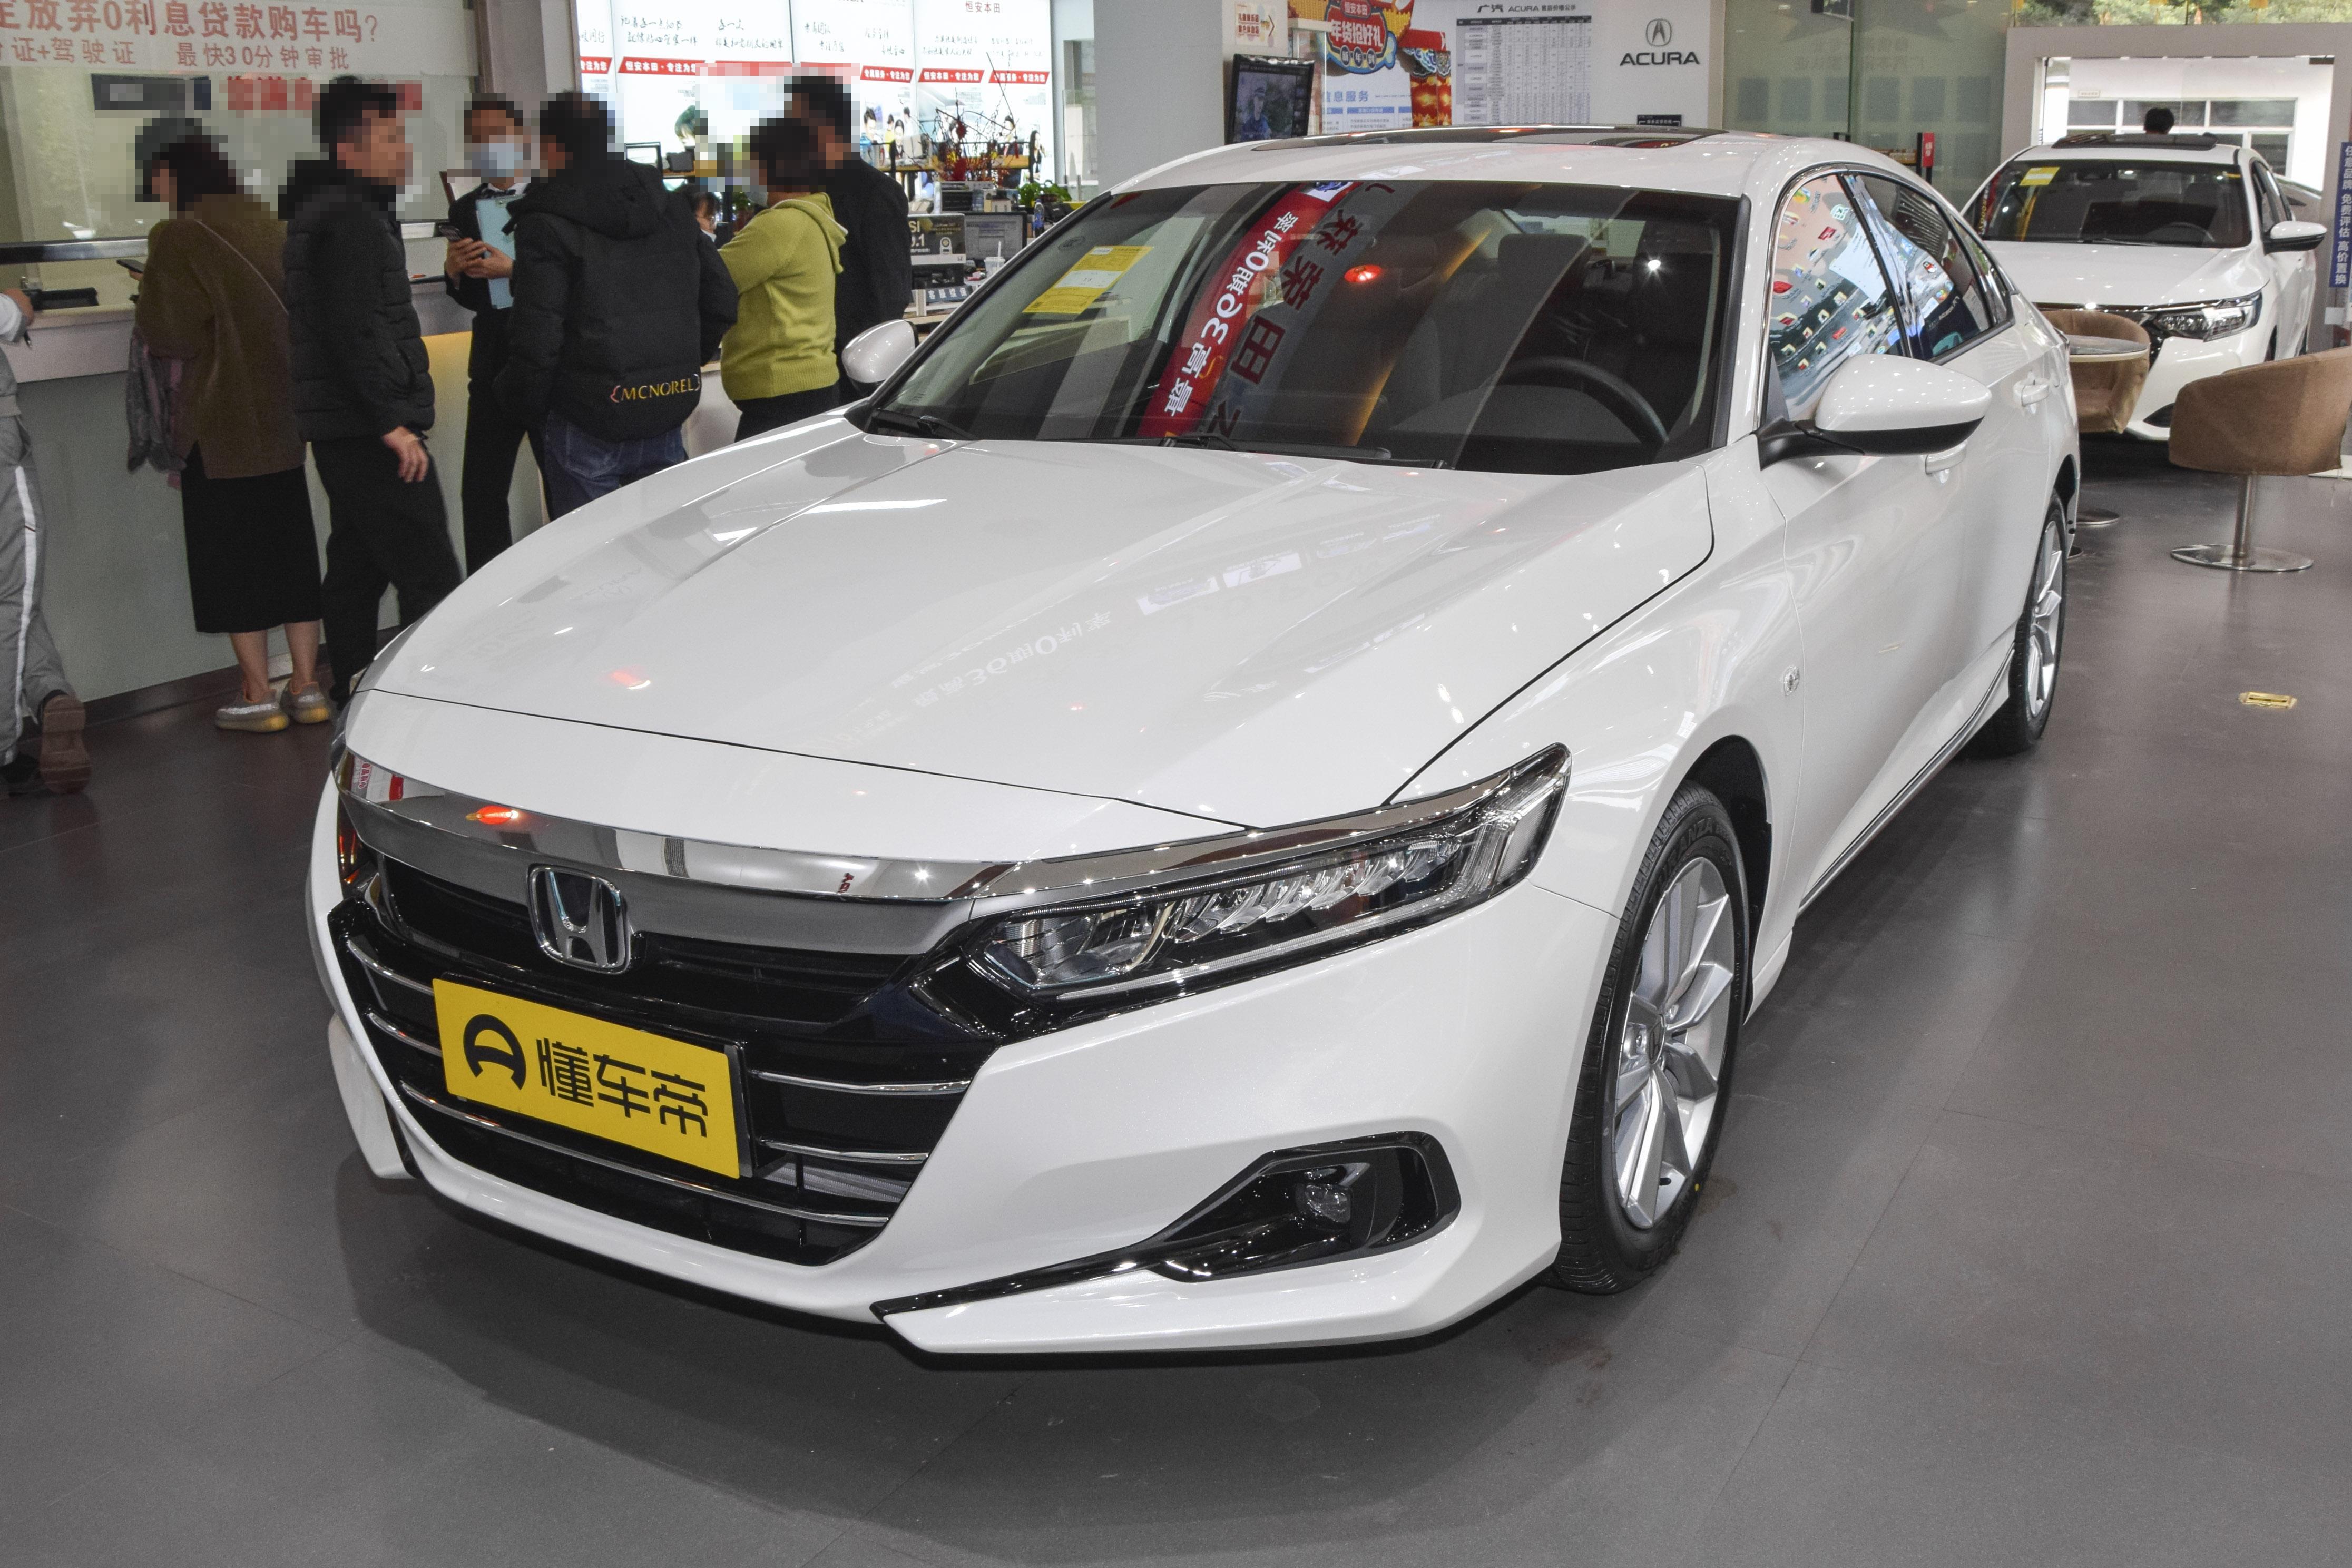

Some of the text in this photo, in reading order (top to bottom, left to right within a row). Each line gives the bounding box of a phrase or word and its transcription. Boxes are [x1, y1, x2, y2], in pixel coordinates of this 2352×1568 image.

[965, 1, 1001, 13] 恒安本田
[1331, 19, 1384, 47] 年货抢好礼
[0, 37, 349, 70] 证+驾驶证 最快30分钟审批
[1619, 51, 1700, 66] ACURA
[536, 1037, 708, 1138] 懂车帝
